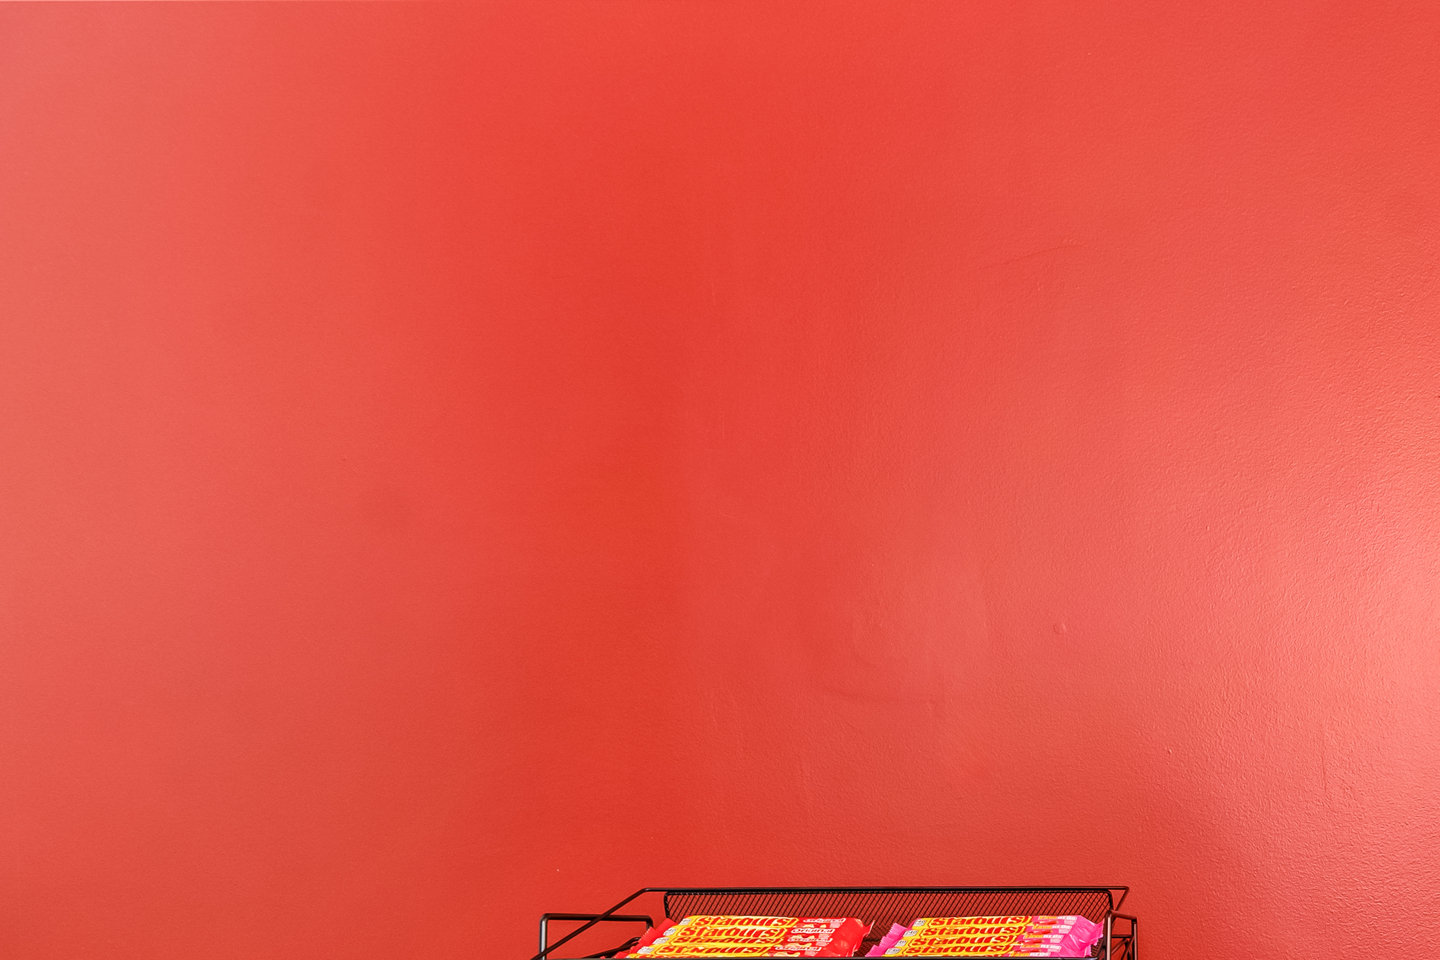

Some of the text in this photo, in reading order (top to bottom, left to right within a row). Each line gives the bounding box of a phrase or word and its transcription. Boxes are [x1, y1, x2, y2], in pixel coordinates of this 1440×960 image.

[695, 915, 796, 927] Starburst
[931, 915, 1029, 926] Starburst
[680, 927, 788, 938] Starburst
[923, 925, 1025, 936] Starburst
[912, 935, 1018, 945] Starburst
